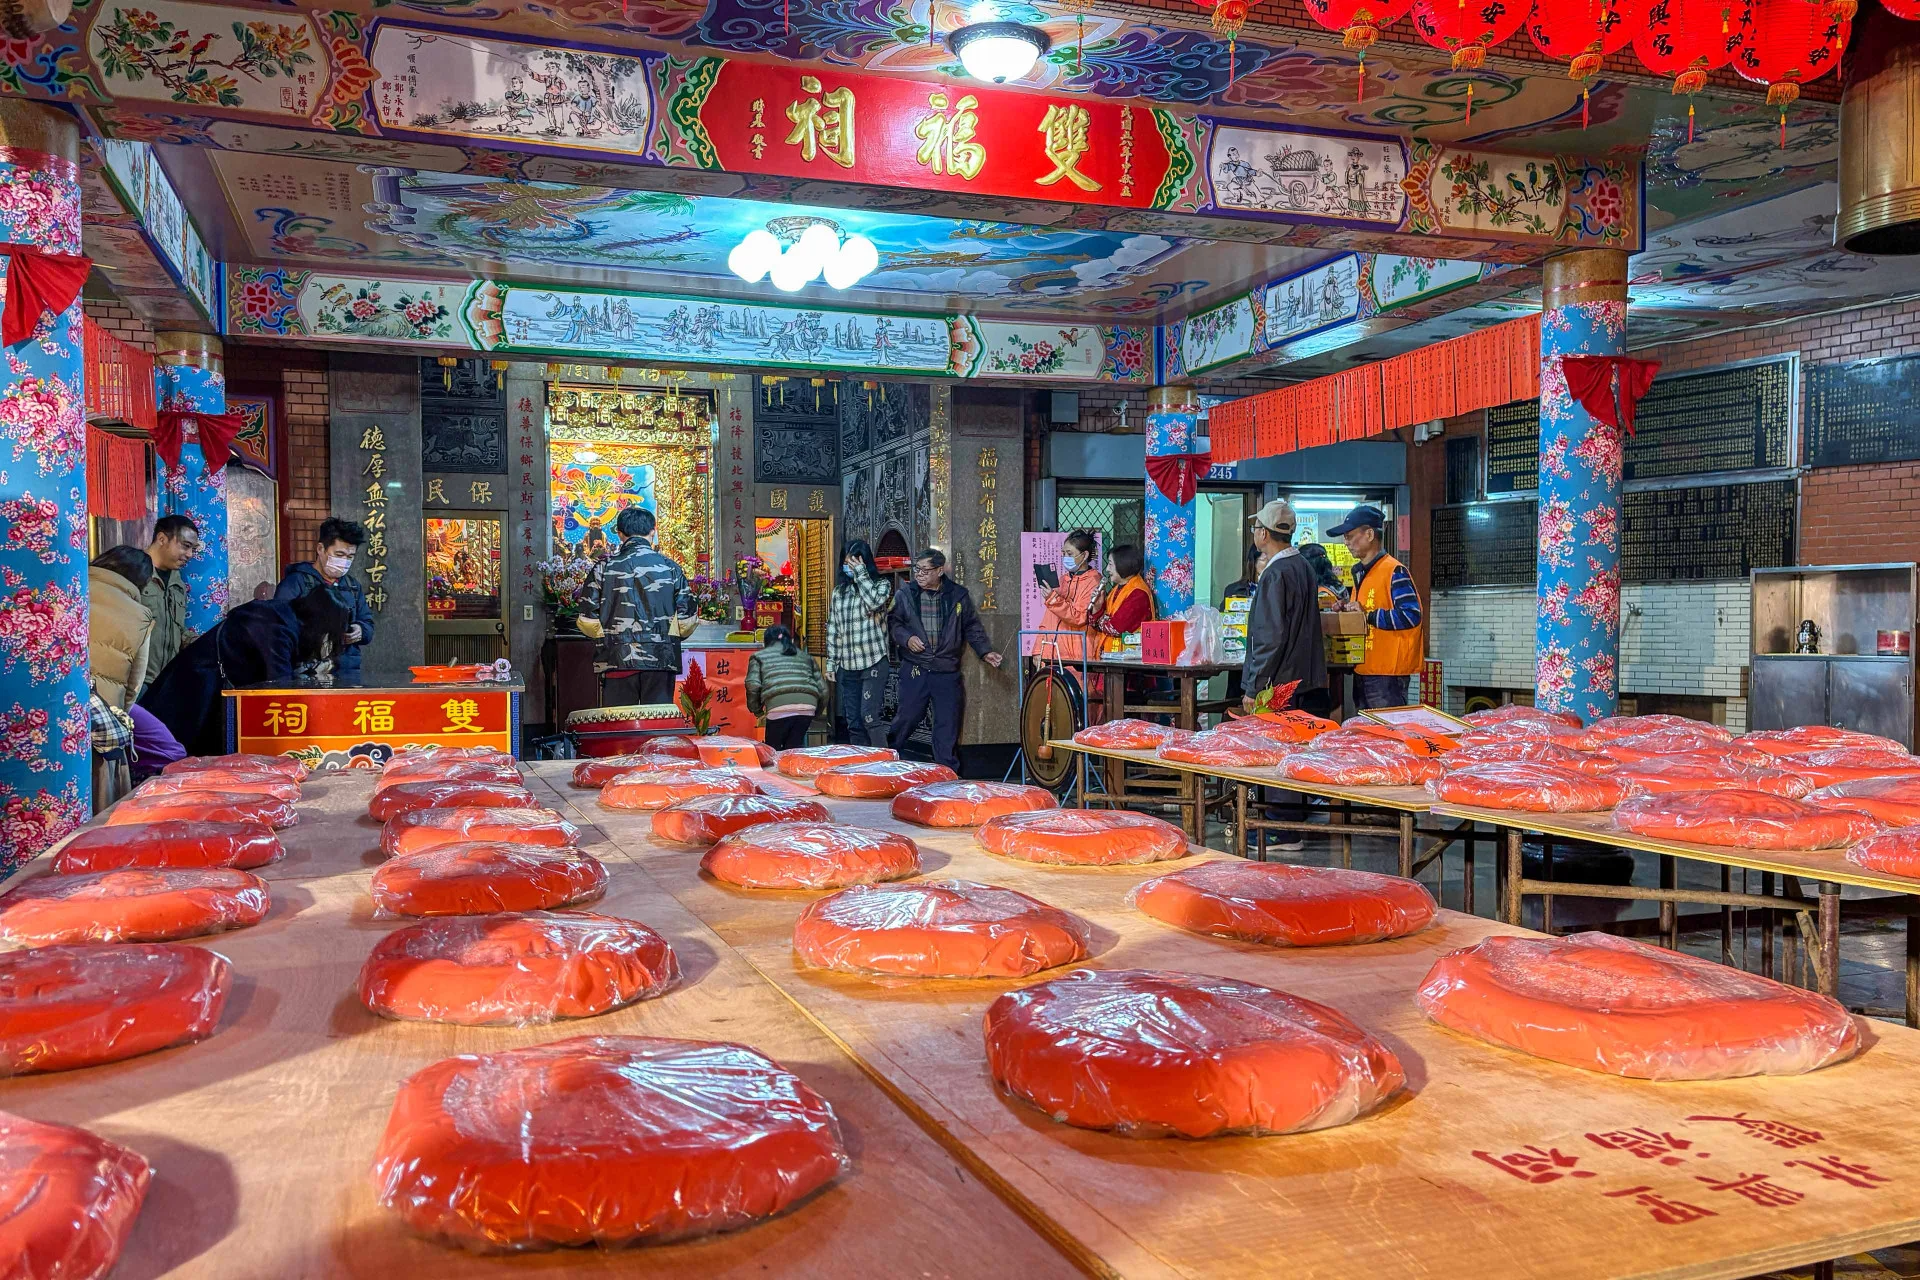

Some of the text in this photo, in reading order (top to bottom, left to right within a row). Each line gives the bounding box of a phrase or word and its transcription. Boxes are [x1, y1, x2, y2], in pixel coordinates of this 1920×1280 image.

[784, 76, 1102, 193] 雙福祠
[1210, 467, 1233, 480] 245
[359, 426, 389, 612] 德厚無私萬古神
[263, 698, 484, 736] 雙福祠
[716, 658, 733, 727] 出現二
